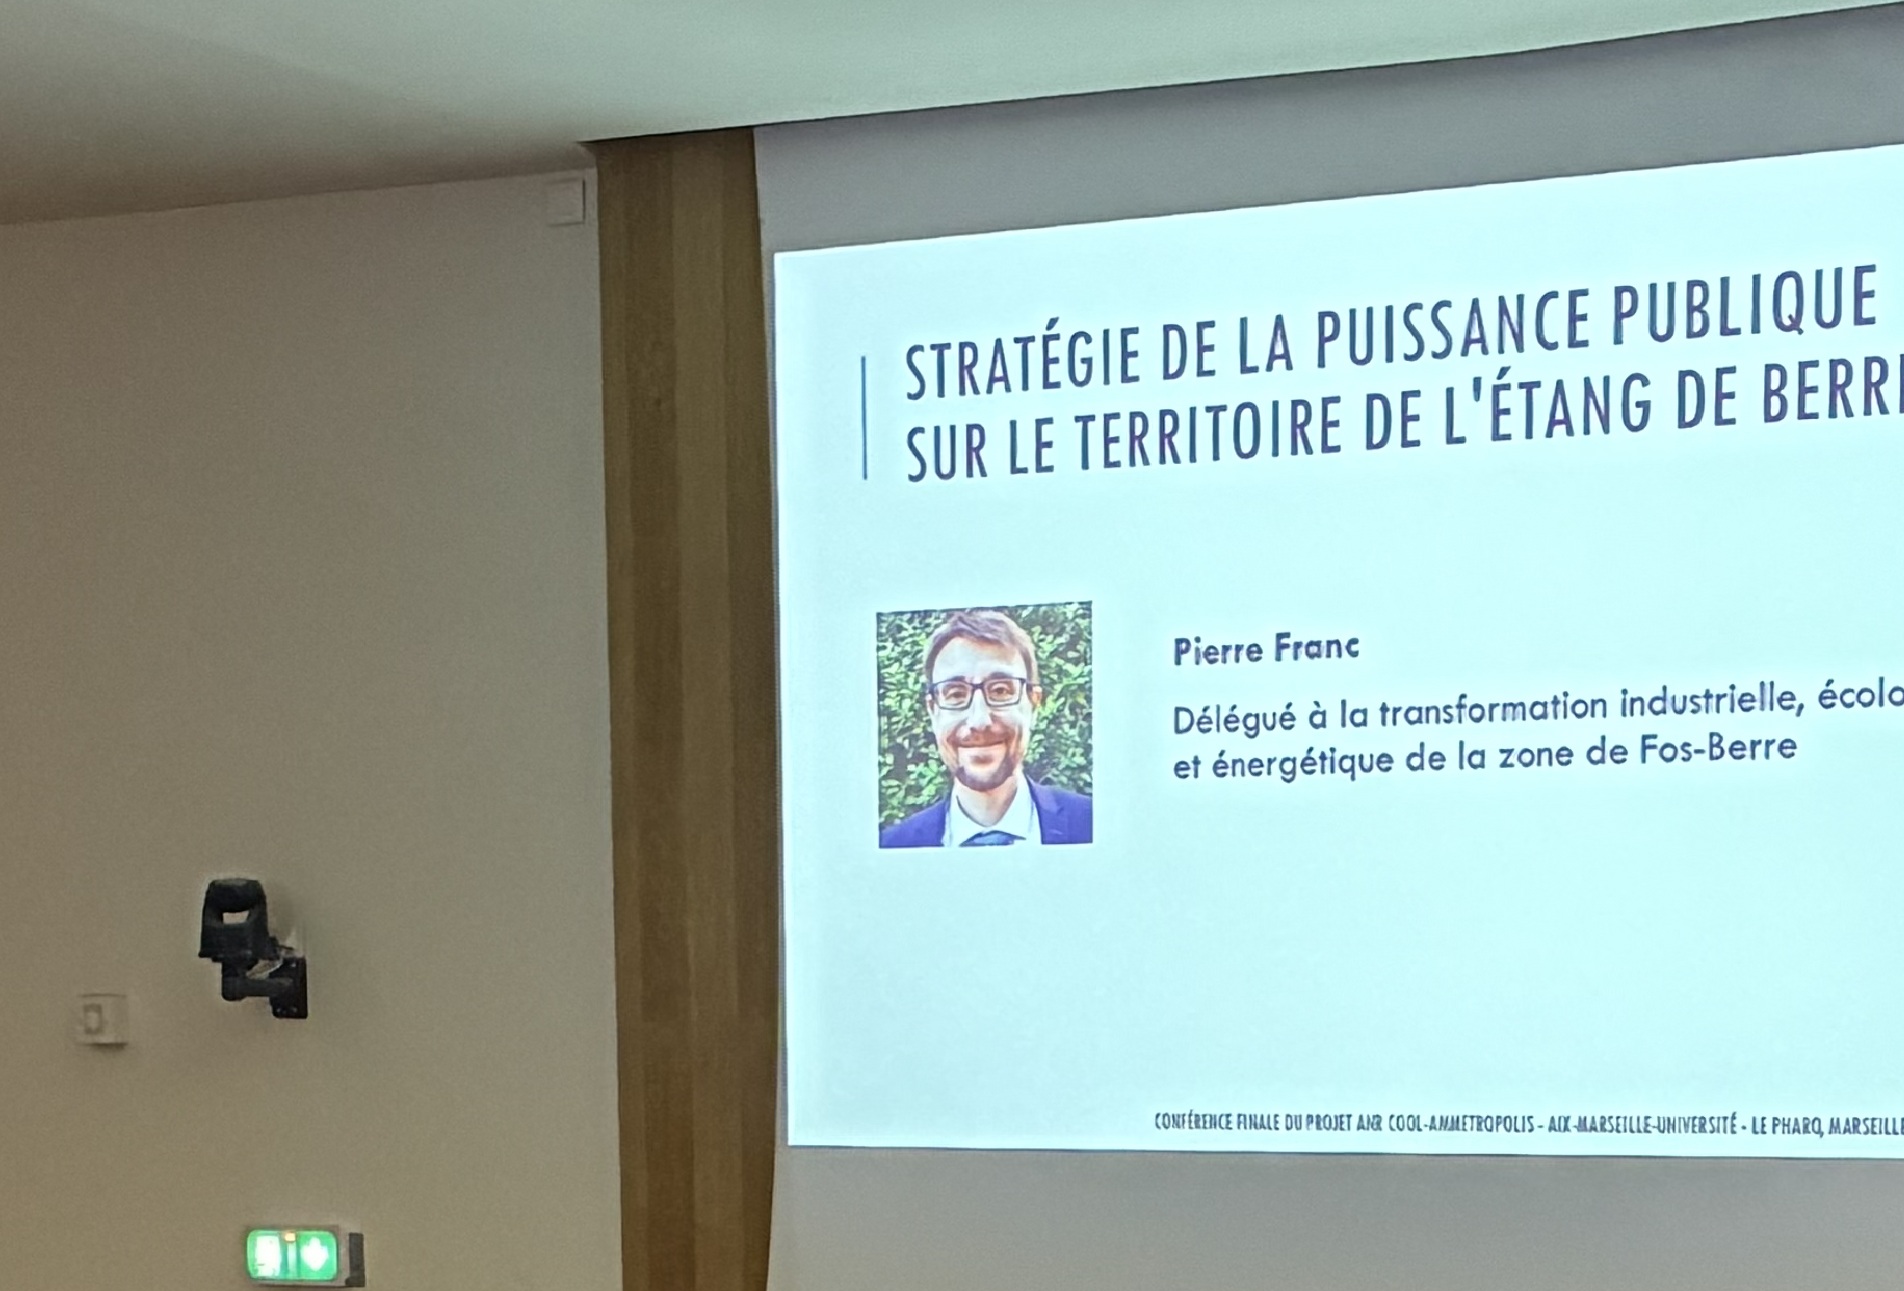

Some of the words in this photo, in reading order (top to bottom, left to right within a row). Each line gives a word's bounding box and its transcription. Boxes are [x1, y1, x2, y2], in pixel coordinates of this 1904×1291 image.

[905, 316, 1140, 401] STRATÉGIE
[1162, 320, 1216, 380] DE
[1239, 314, 1294, 374] LA
[1317, 288, 1590, 369] PUISSANCE
[1613, 264, 1877, 345] PUBLIQUE
[906, 423, 988, 483] SUR
[1009, 417, 1055, 475] LE
[1074, 395, 1342, 471] TERRITOIRE
[1365, 389, 1422, 451] DE
[1444, 366, 1652, 445] L'ÉTANG
[1676, 365, 1737, 430] DE
[1173, 636, 1264, 666] Pierre
[1274, 632, 1360, 662] Franc
[1173, 701, 1296, 740] Délégué
[1308, 700, 1327, 730] à
[1340, 699, 1369, 729] la
[1379, 691, 1607, 727] transformation
[1620, 680, 1805, 718] industrielle,
[1173, 755, 1201, 780] et
[1212, 747, 1395, 783] énergétique
[1405, 741, 1447, 772] de
[1458, 740, 1486, 770] la
[1499, 743, 1575, 769] zone
[1586, 734, 1629, 766] de
[1641, 731, 1798, 764] Fos-Berre
[1154, 1109, 1234, 1131] CONFÉRENCE
[1237, 1112, 1280, 1131] FINALE
[1285, 1113, 1303, 1131] DU
[1306, 1113, 1352, 1132] PROJET
[1751, 1116, 1767, 1135] LE
